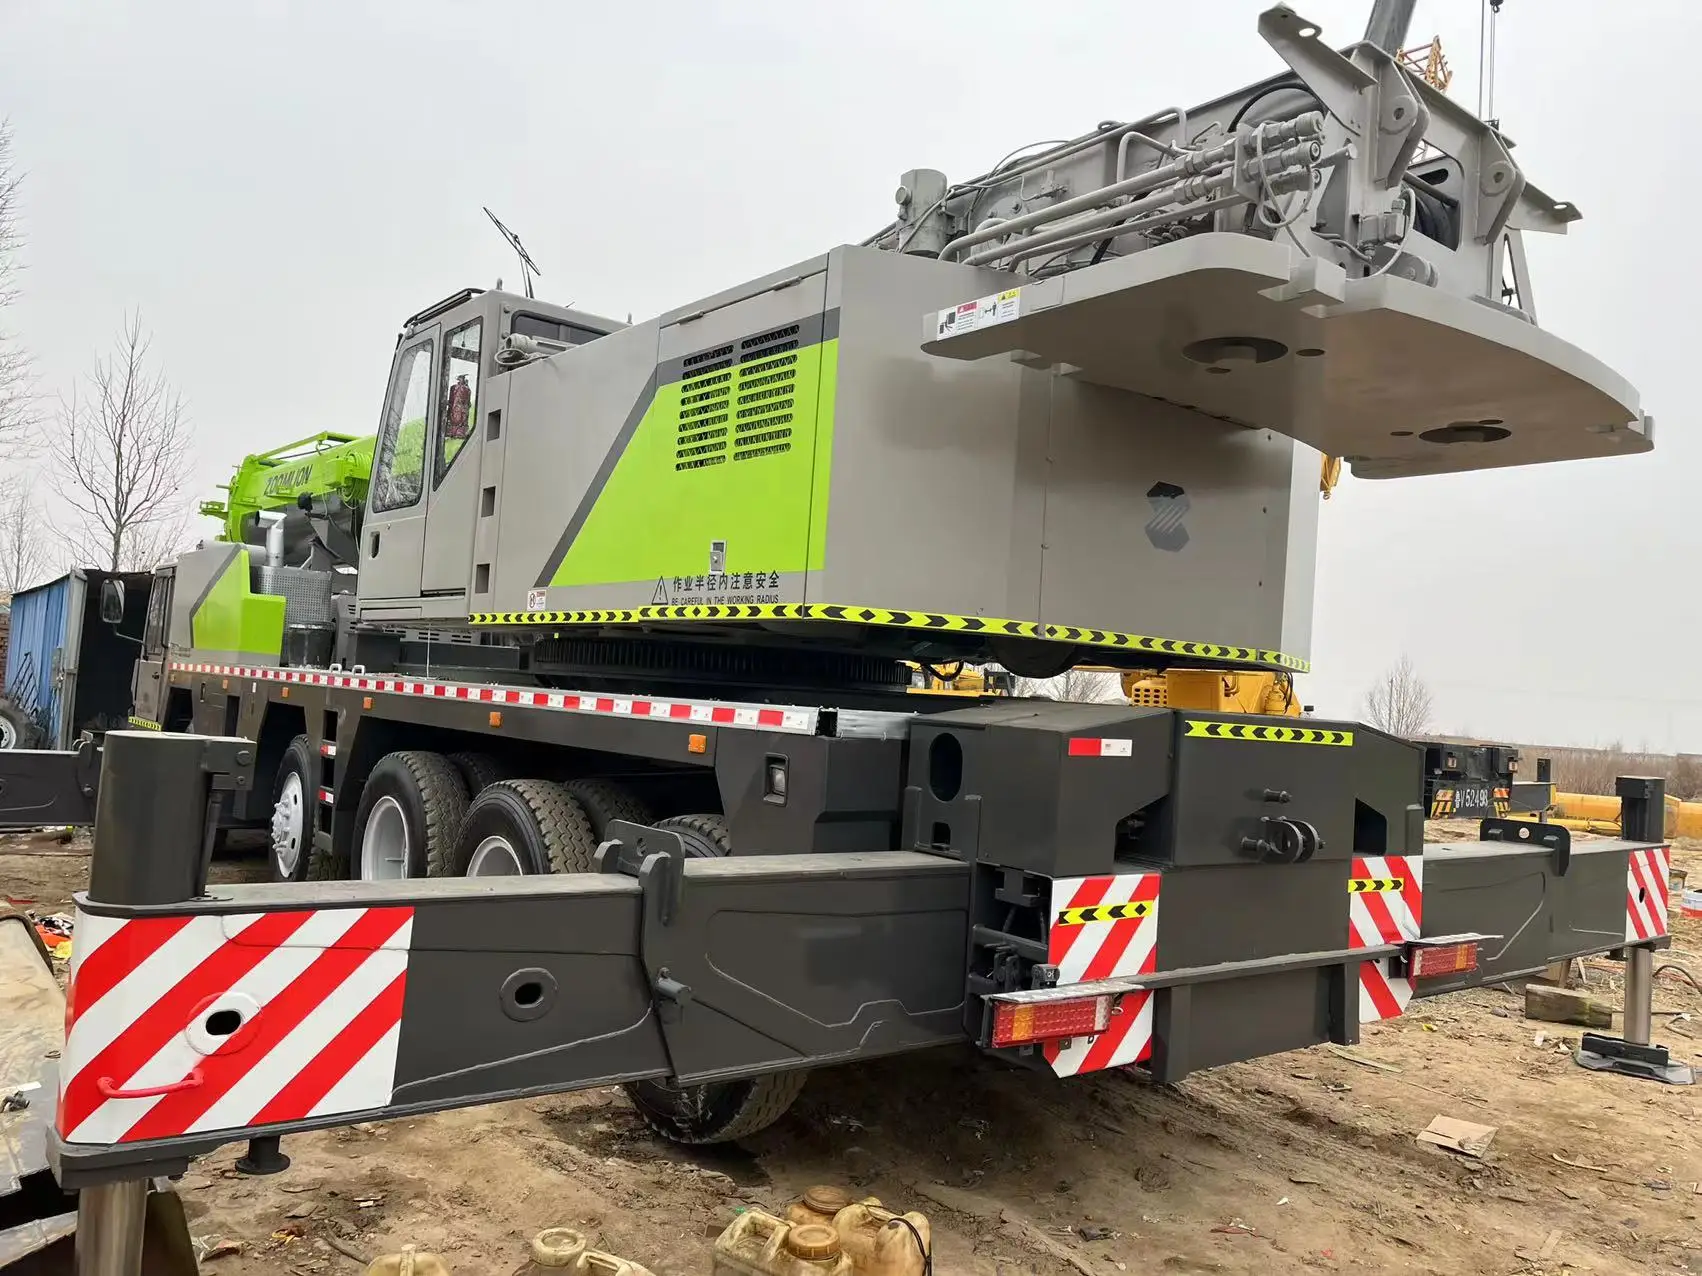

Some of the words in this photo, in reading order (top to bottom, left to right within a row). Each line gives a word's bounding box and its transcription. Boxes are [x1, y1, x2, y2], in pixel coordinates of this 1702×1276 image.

[263, 464, 313, 496] ZOOMLION
[673, 570, 780, 592] 作业半径内注意安全
[671, 597, 678, 606] BE
[680, 596, 704, 606] CAREFUL
[714, 595, 725, 605] THE
[727, 594, 754, 604] WORKING
[756, 594, 779, 604] RADIUS
